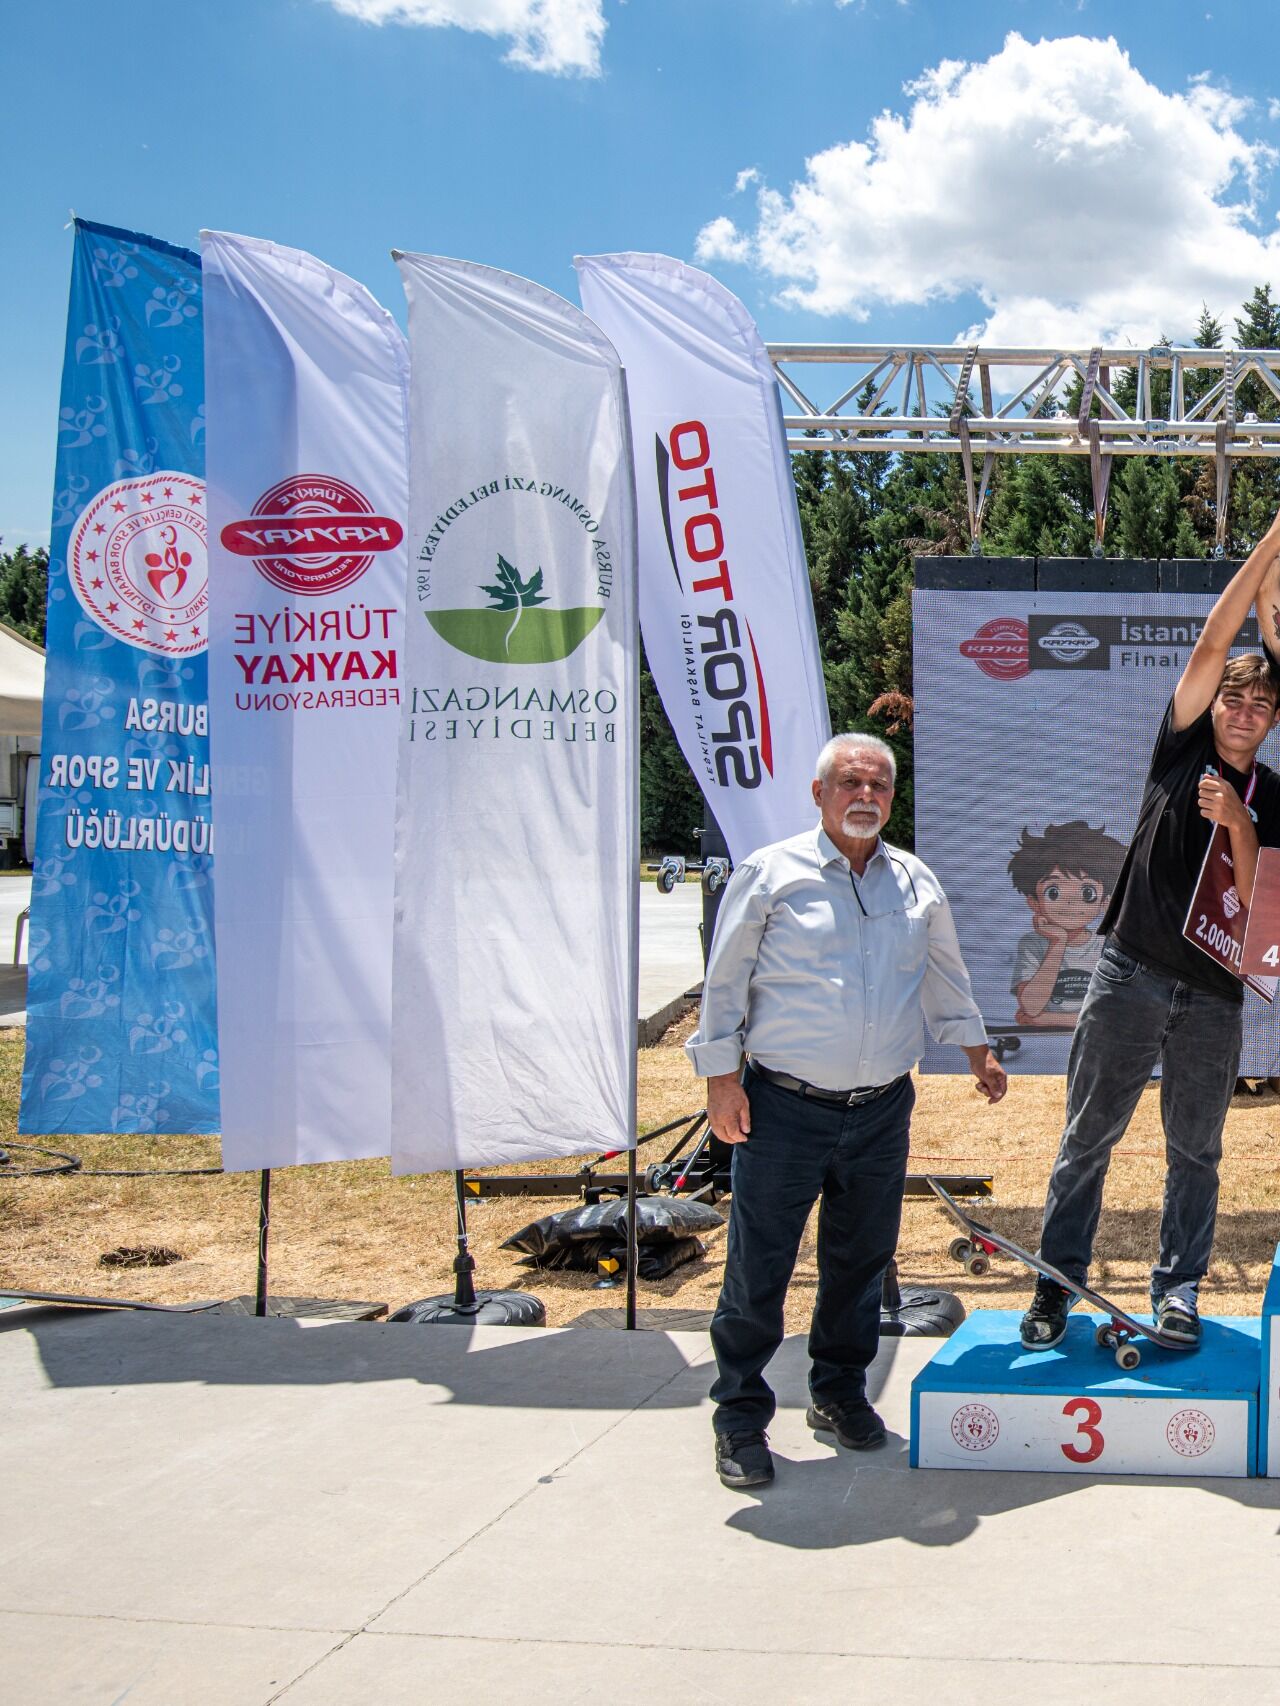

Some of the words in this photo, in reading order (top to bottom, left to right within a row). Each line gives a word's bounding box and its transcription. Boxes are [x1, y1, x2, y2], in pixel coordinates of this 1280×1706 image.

[1121, 617, 1203, 642] İstanb
[1121, 652, 1179, 667] Final
[1195, 914, 1242, 967] 2.000TL
[1060, 1397, 1105, 1464] 3
